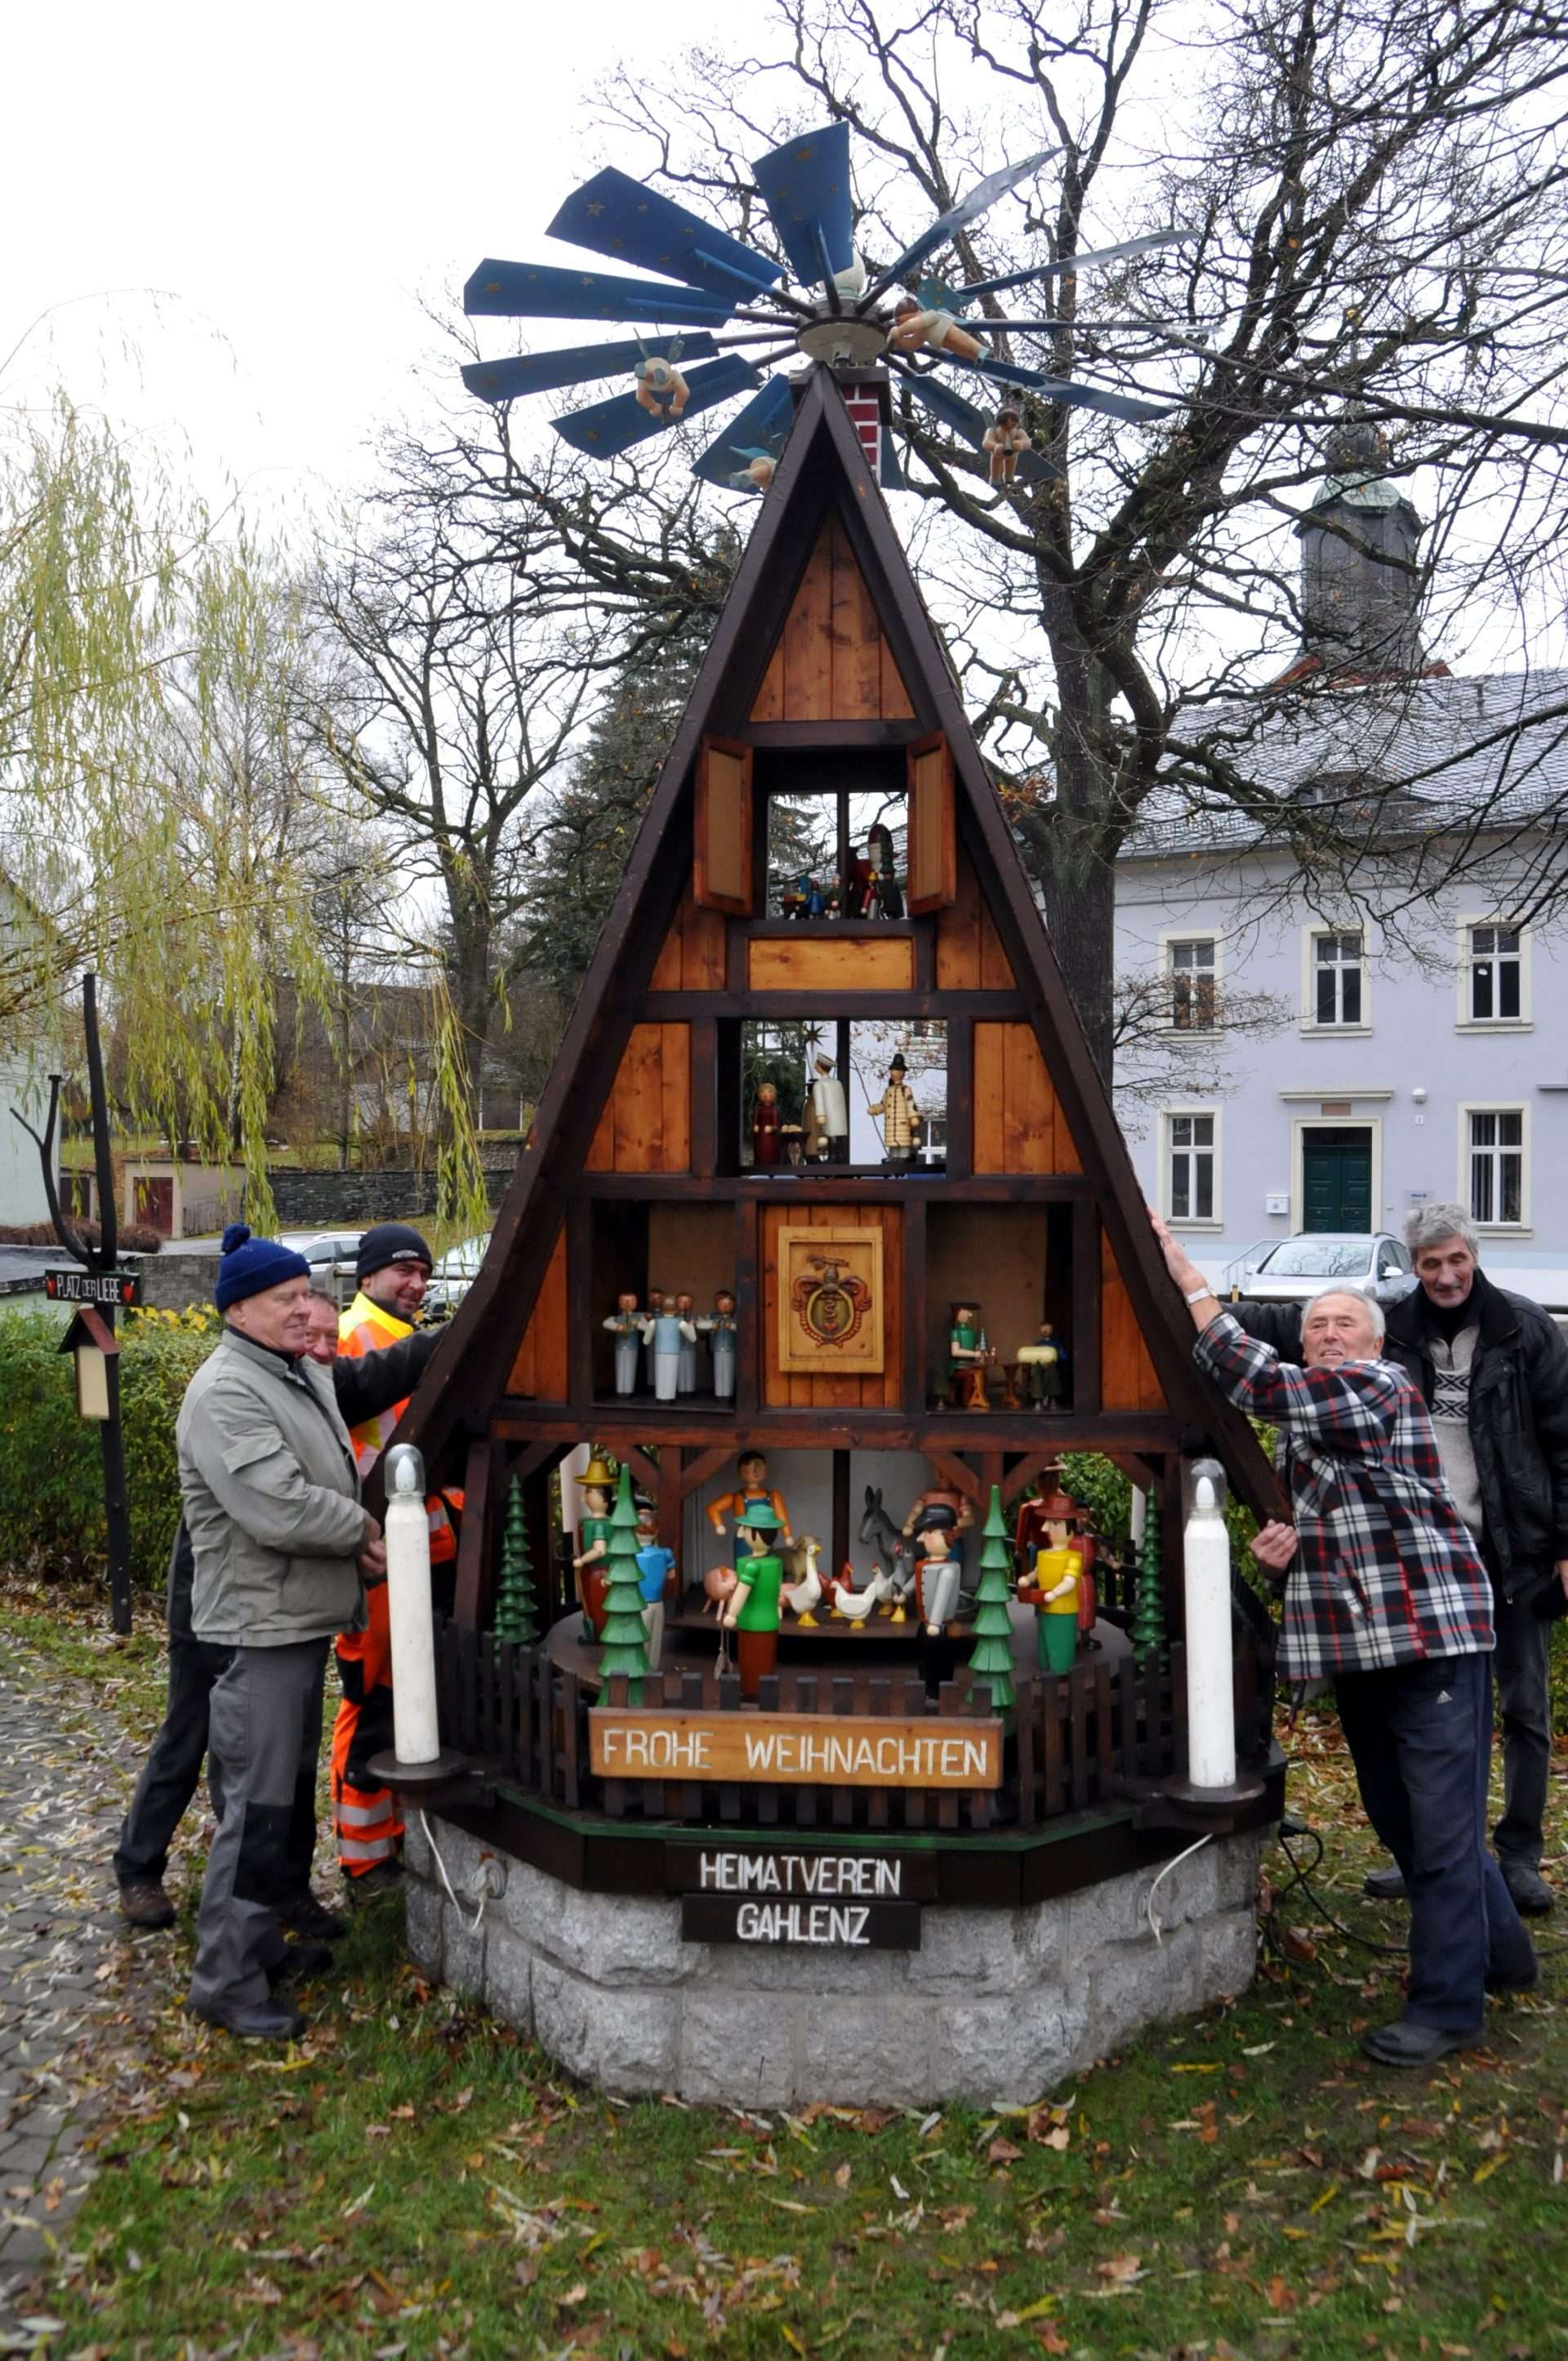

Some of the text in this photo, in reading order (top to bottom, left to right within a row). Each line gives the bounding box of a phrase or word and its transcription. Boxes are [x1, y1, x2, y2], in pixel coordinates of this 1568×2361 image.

[56, 1275, 121, 1303] PLATZ DER LIEBE
[603, 1729, 987, 1777] FROHE WEIHNACHTEN
[700, 1852, 901, 1895] HEIMATVEREIN
[737, 1903, 871, 1944] GAHLENZ
